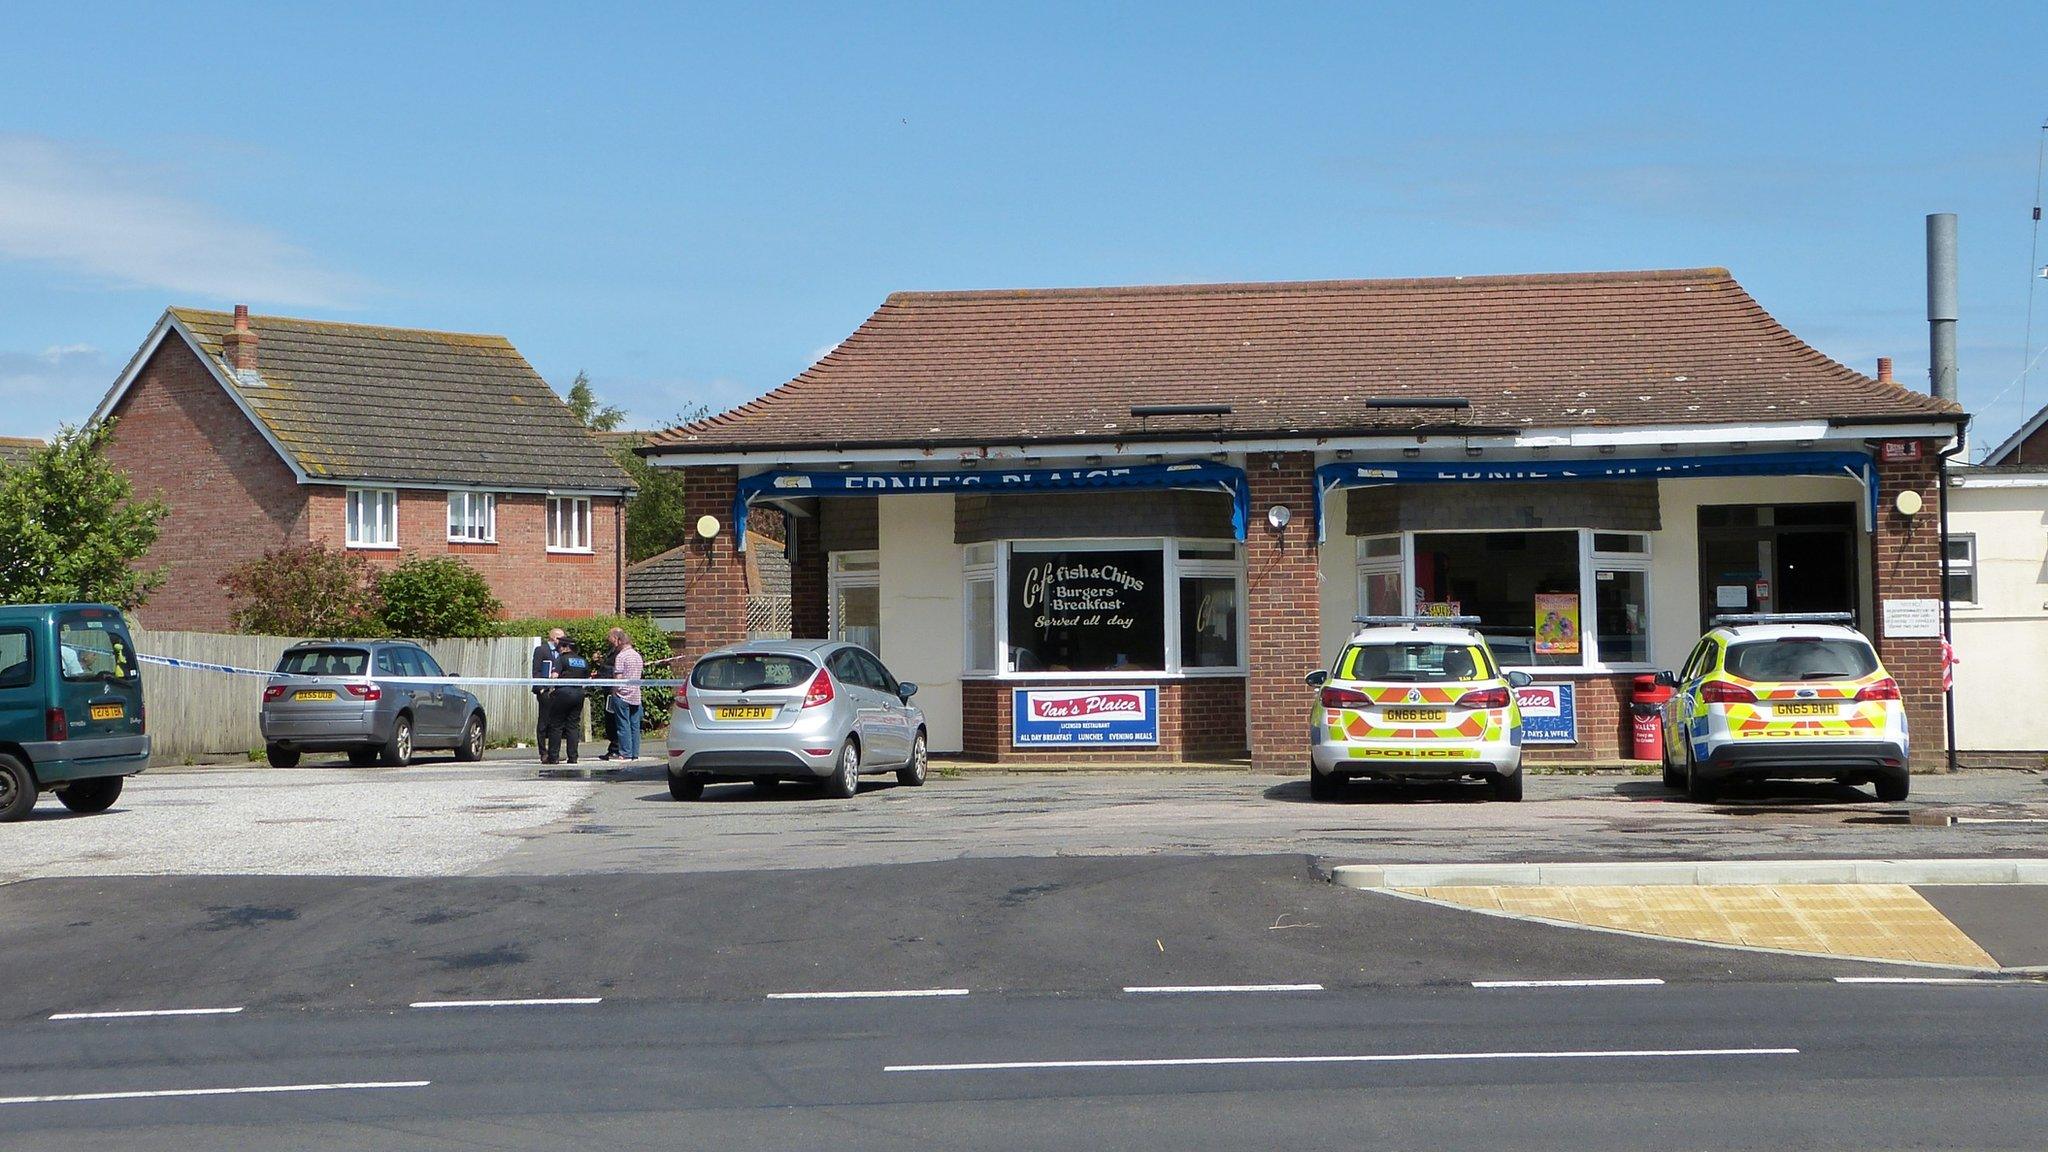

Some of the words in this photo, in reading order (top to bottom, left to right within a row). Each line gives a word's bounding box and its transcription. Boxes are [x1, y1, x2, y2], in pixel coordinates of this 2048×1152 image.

[1101, 565, 1144, 591] Chips
[1023, 562, 1055, 609] Cafe
[1056, 586, 1115, 600] Burgers
[1052, 599, 1122, 610] Breakfast
[1034, 615, 1080, 628] Served
[1083, 615, 1101, 626] all
[1107, 614, 1134, 629] day
[1040, 700, 1080, 717] Ian's
[1085, 696, 1136, 714] Plaice
[1777, 704, 1808, 714] GN65
[1811, 703, 1835, 714] BWH
[1387, 710, 1417, 720] GN66
[1042, 733, 1072, 741] BREAKFAST
[1108, 732, 1134, 740] EVENING
[1134, 732, 1153, 740] MEALS
[1365, 749, 1465, 757] POLICE
